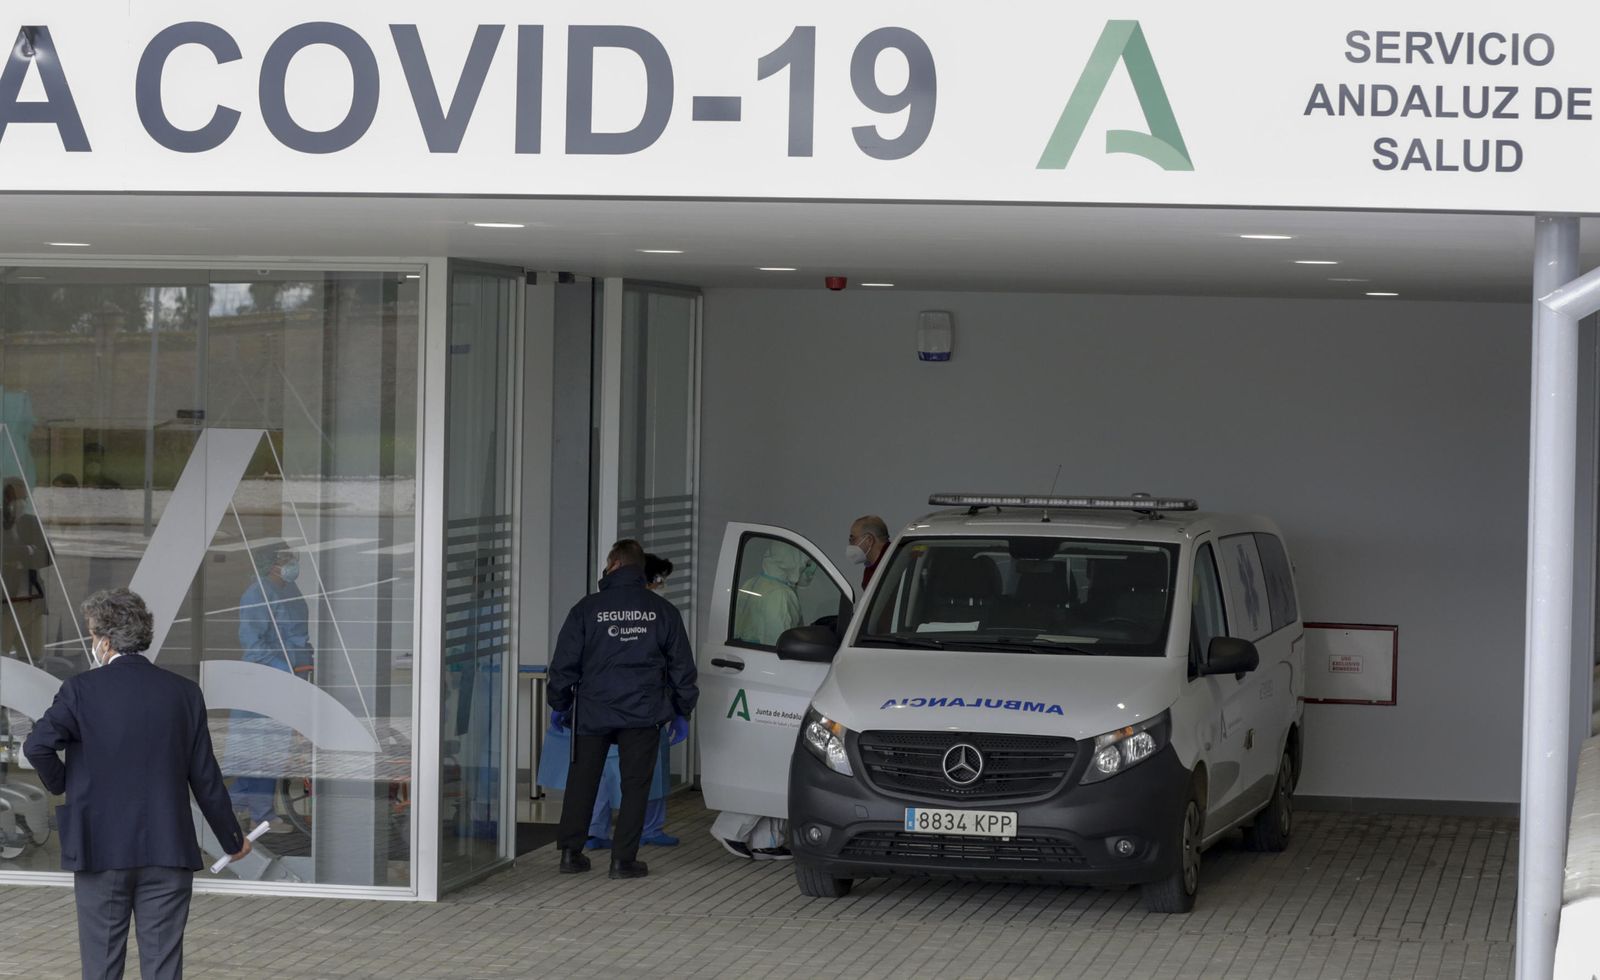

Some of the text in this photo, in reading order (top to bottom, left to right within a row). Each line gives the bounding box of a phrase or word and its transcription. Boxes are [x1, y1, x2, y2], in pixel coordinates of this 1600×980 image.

[1344, 29, 1555, 67] SERVICIO
[0, 20, 938, 160] A COVID-19
[1303, 83, 1593, 121] ANDALUZ DE
[1372, 136, 1524, 173] SALUD
[596, 610, 657, 622] SEGURIDAD
[620, 626, 647, 635] ILUNION
[755, 708, 773, 717] Junta
[773, 710, 781, 718] de
[919, 811, 1012, 833] 8834 KPP
